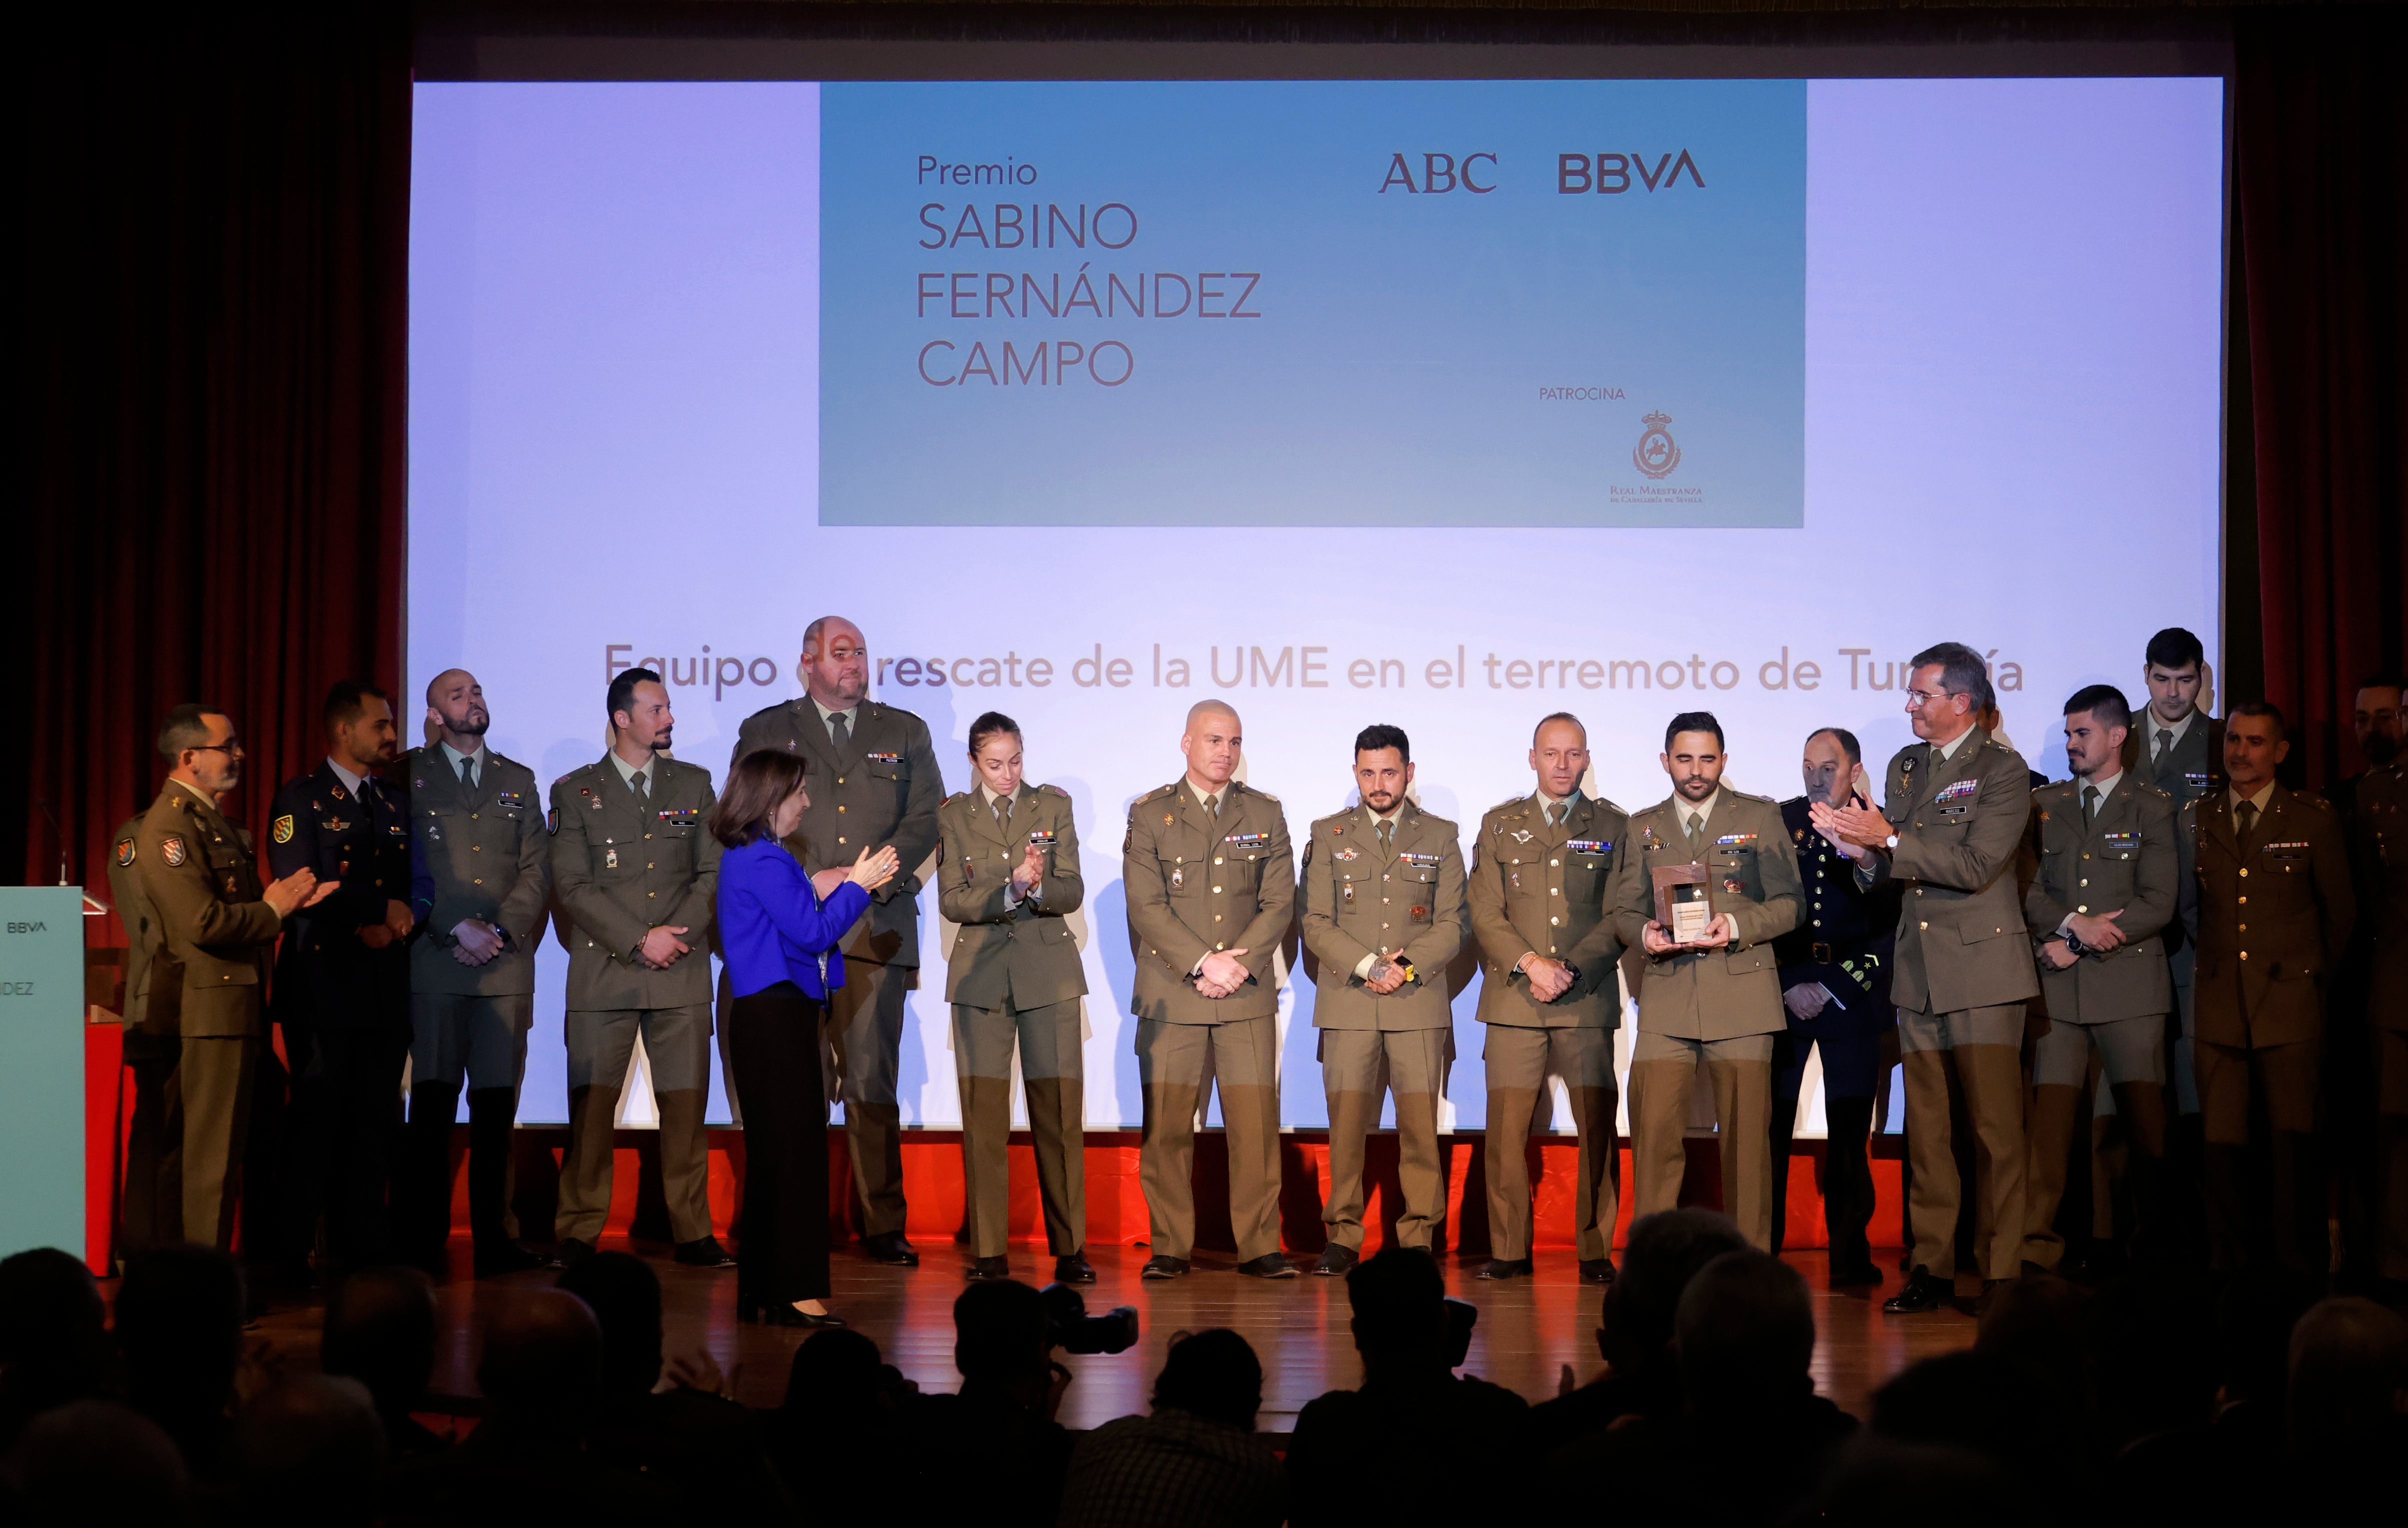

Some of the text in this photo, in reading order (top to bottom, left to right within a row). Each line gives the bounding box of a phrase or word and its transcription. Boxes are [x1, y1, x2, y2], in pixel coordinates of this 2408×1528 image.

[919, 156, 1038, 186] Premio
[1379, 153, 1498, 194] ABC
[1558, 149, 1706, 195] BBVA
[919, 203, 1138, 250] SABINO
[919, 262, 1261, 319] FERNÁNDEZ
[919, 340, 1134, 387] CAMPO
[1539, 387, 1625, 401] PATROCINA
[877, 651, 1053, 688] rescate
[1072, 643, 1133, 688] de
[1153, 643, 1190, 688] la
[1211, 646, 1329, 688] UME
[1348, 659, 1405, 689] en
[1425, 645, 1465, 689] el
[1483, 652, 1740, 690] terremoto
[1758, 646, 1821, 691] de
[1838, 649, 2023, 691] Turía
[7, 921, 47, 933] BBVA
[0, 982, 34, 996] DEZ
